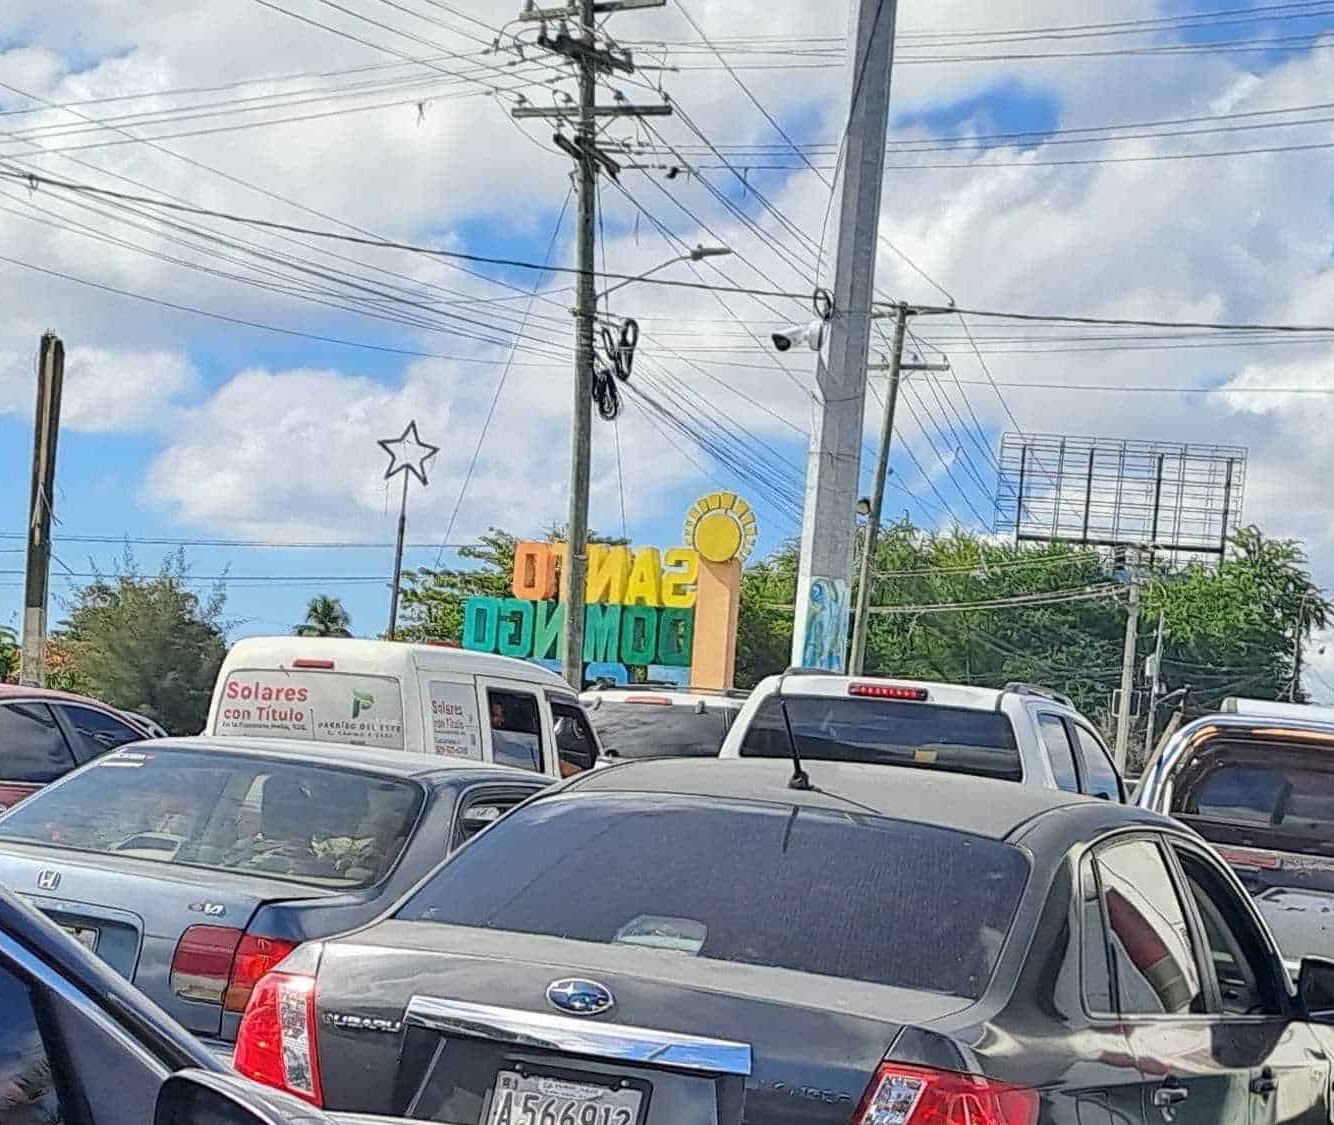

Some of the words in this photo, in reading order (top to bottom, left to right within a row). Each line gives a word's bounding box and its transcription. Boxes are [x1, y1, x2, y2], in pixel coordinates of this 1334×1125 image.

[226, 681, 308, 702] Solares
[224, 708, 251, 721] con
[256, 705, 304, 722] Título
[323, 1013, 401, 1033] SUBARU
